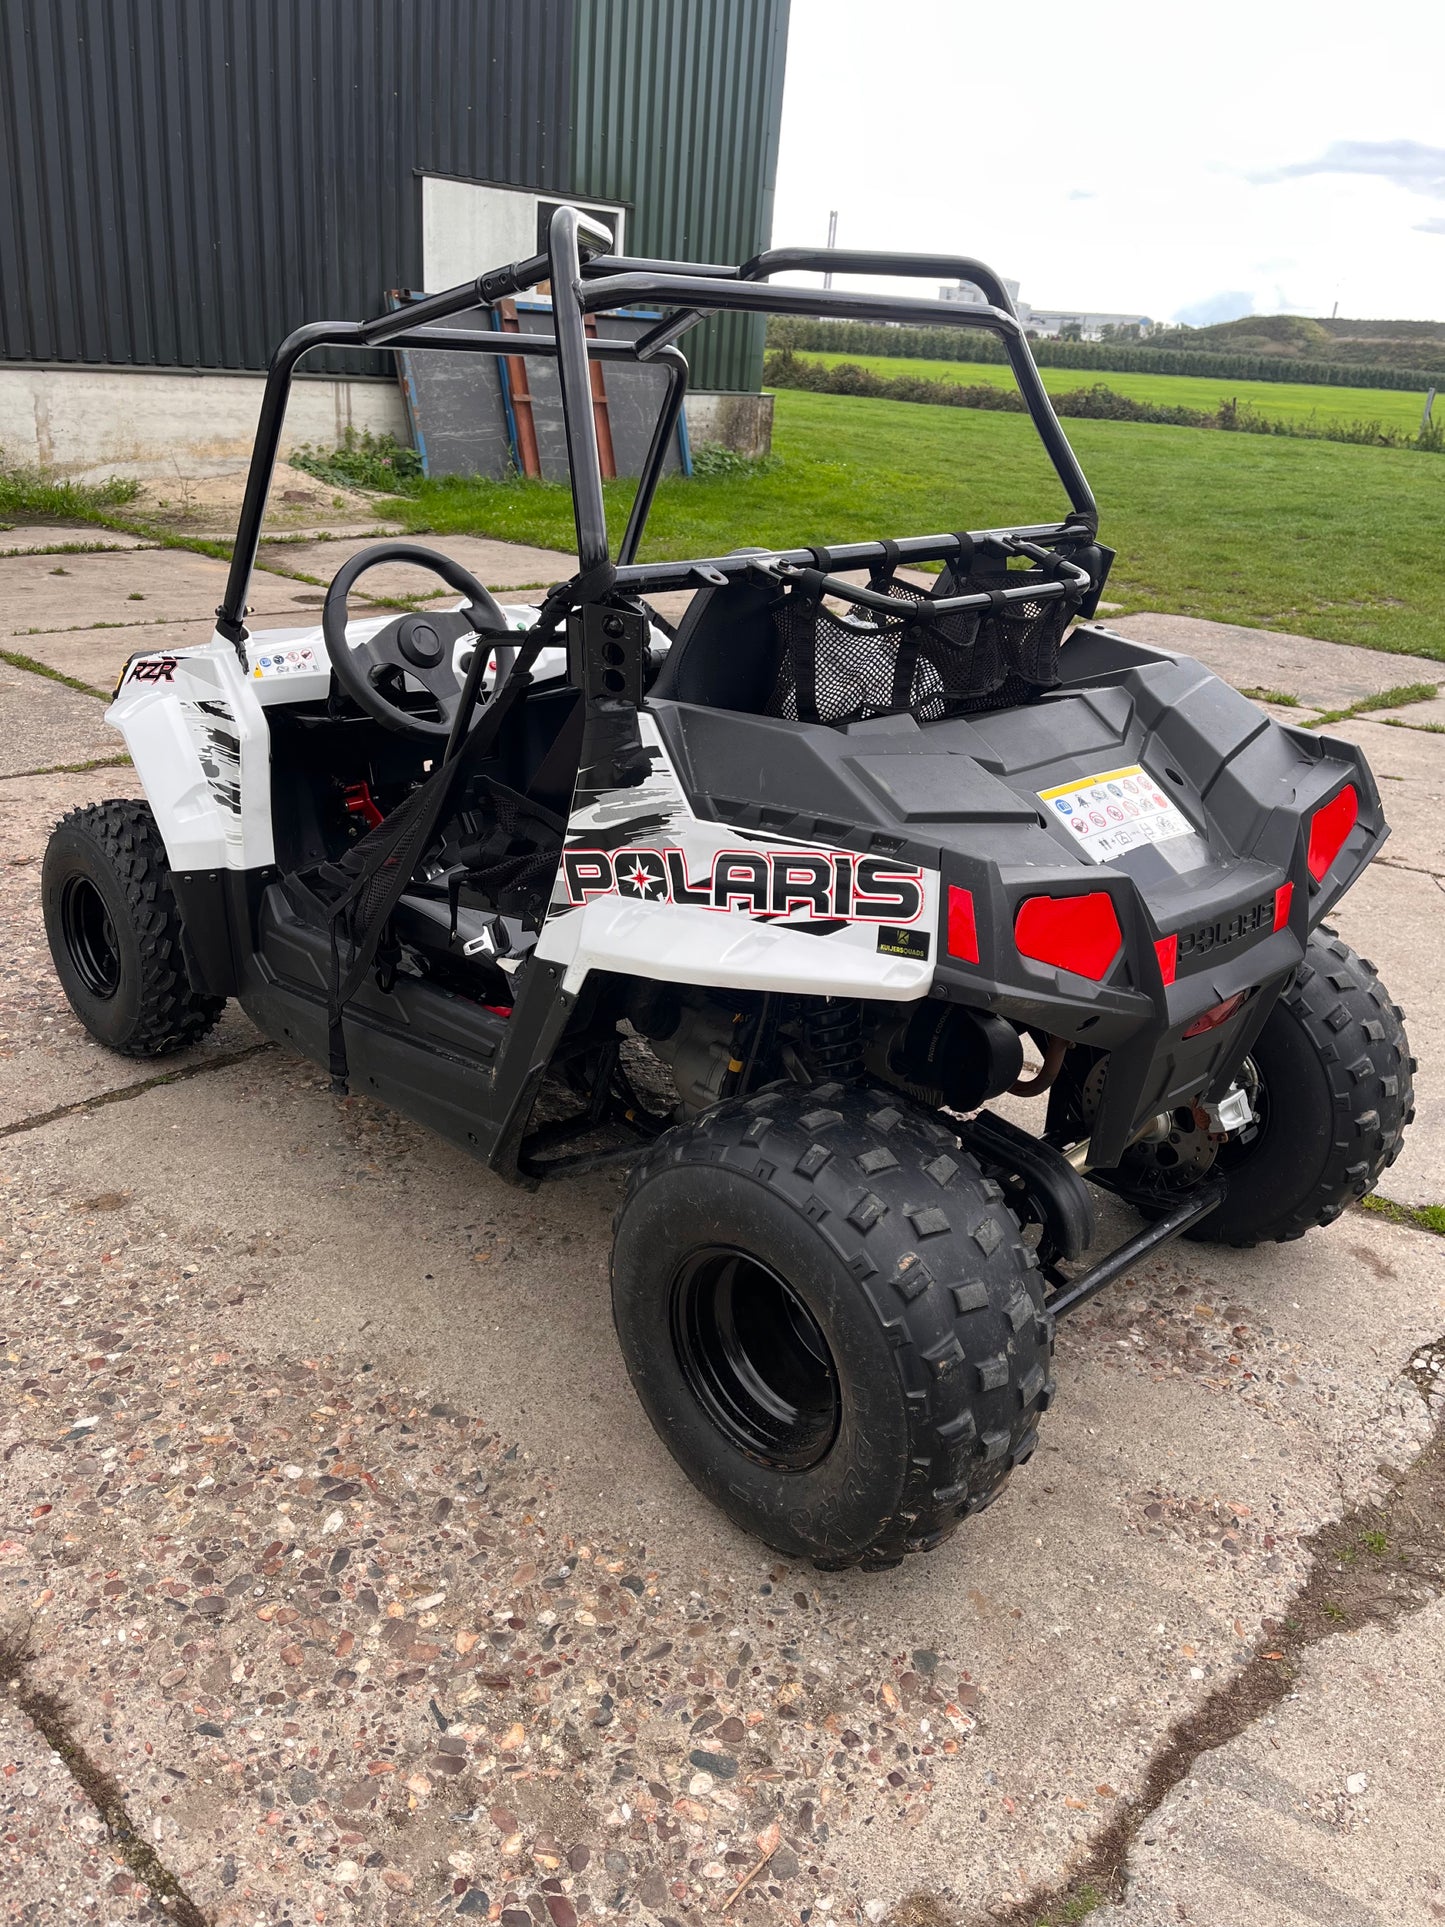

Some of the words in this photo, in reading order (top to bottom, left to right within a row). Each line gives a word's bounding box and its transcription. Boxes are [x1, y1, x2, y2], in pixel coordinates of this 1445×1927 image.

[125, 658, 178, 685] RZR
[563, 848, 924, 923] POLARIS
[1176, 897, 1274, 963] POLARIS
